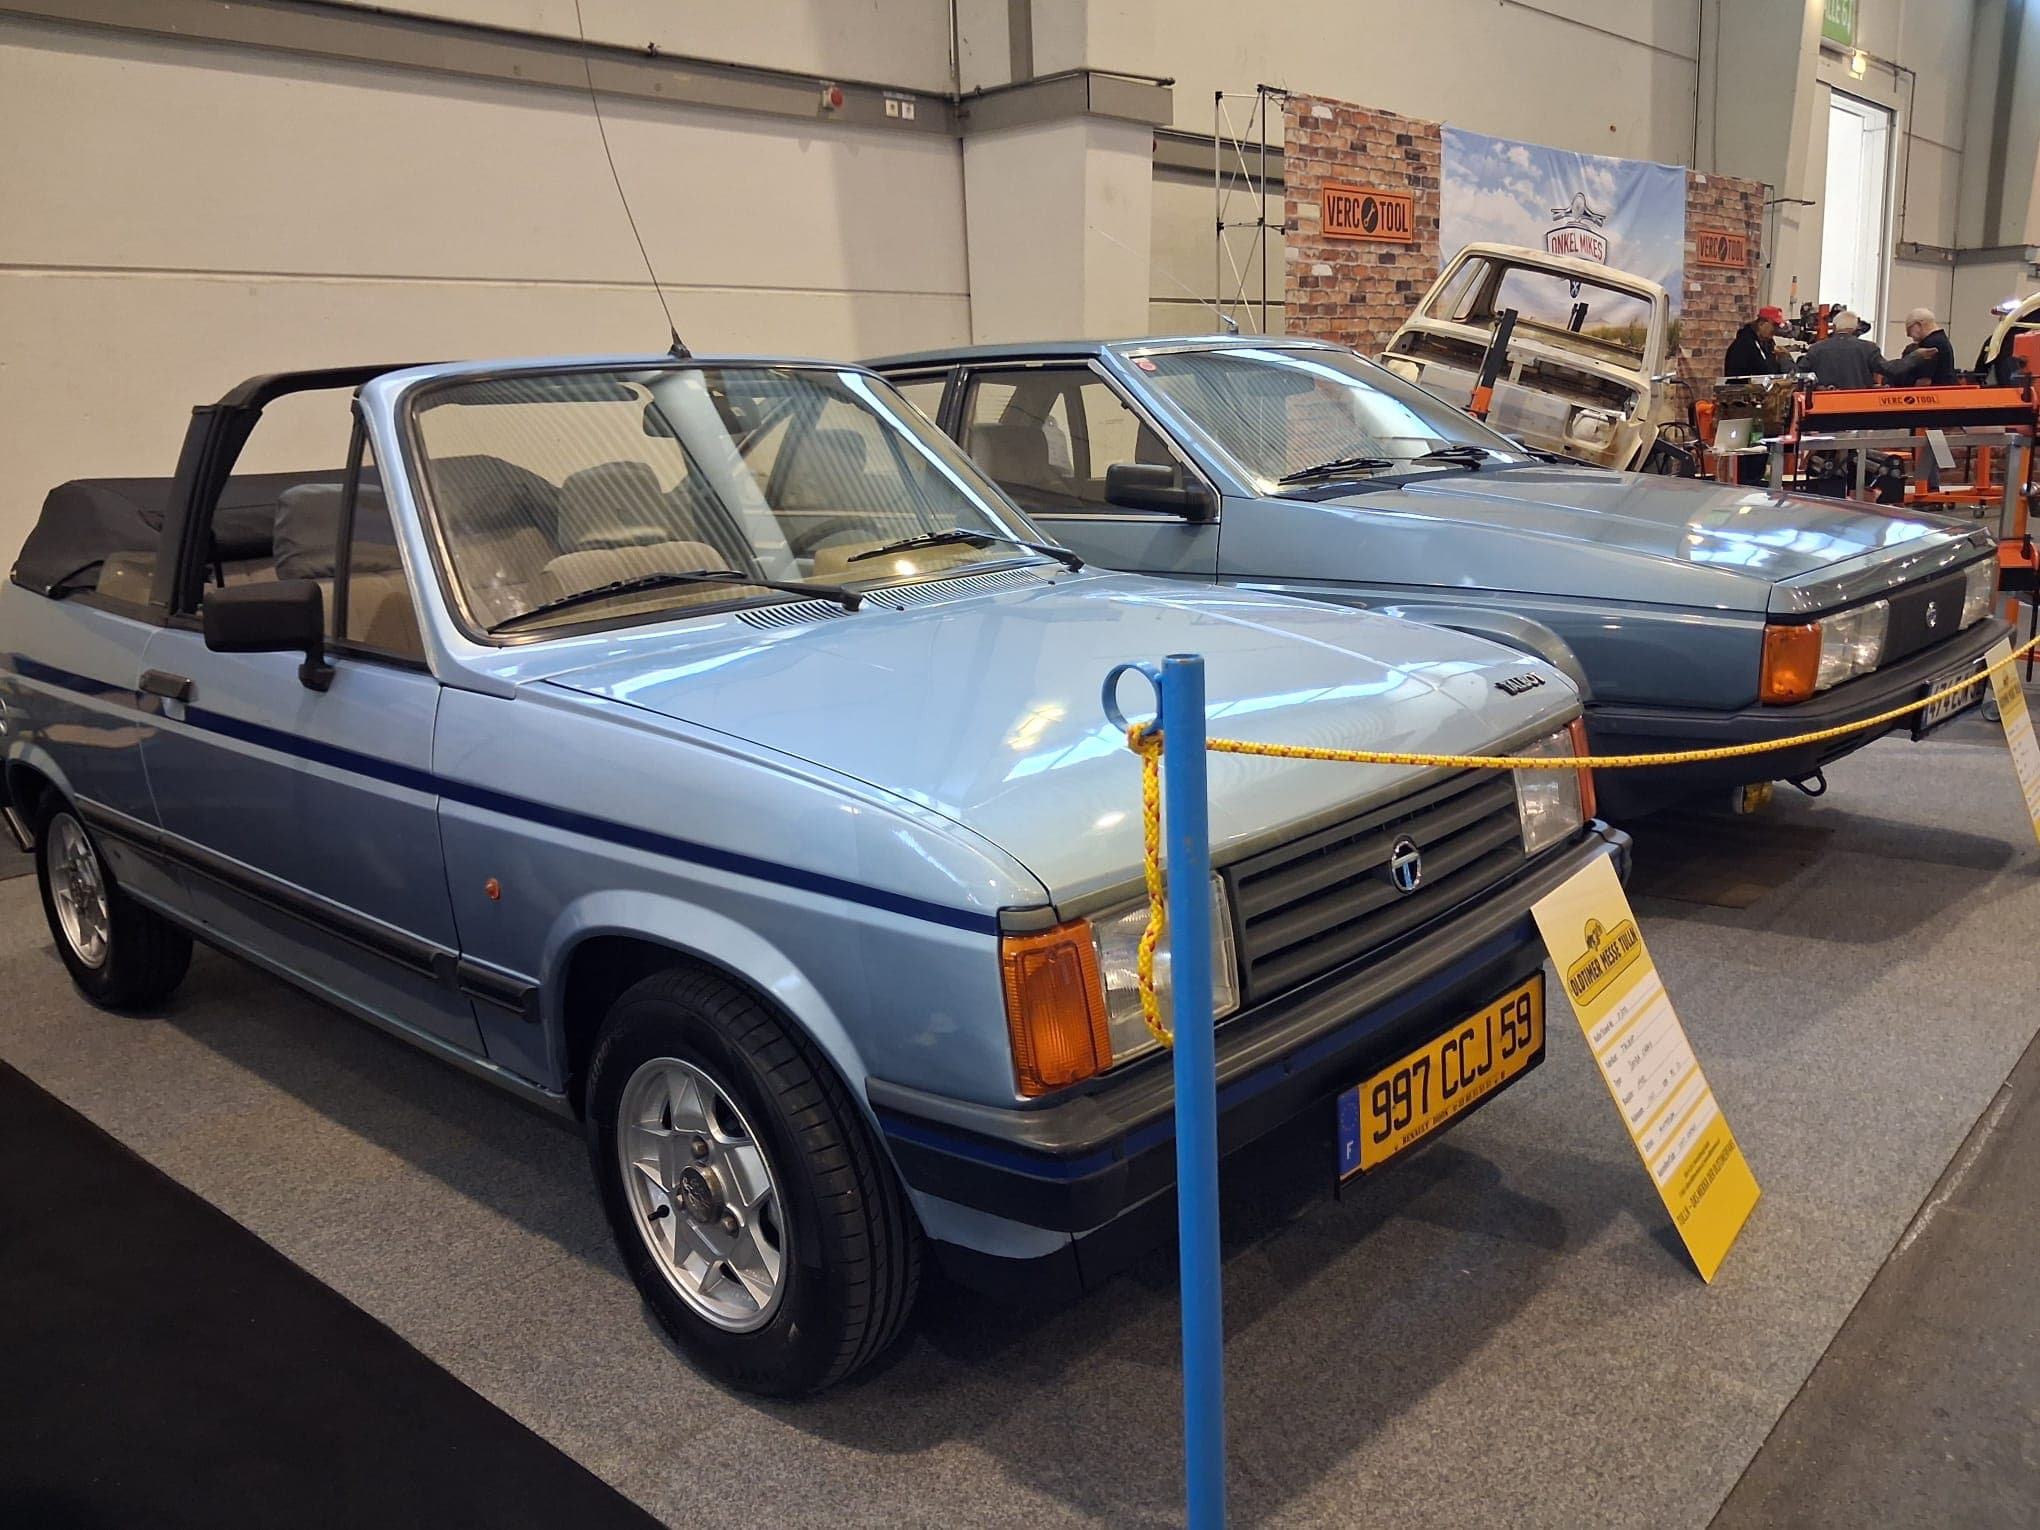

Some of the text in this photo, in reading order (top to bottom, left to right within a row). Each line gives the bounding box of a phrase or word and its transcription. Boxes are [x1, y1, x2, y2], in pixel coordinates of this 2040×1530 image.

[1379, 201, 1409, 233] TOOL
[1551, 232, 1603, 261] ONKEL MIKES
[1570, 926, 1639, 998] OLDTIMER MESSE TULLN
[1372, 1054, 1430, 1144] 997
[1441, 1016, 1492, 1100] CCJ
[1500, 992, 1532, 1060] 59
[1346, 1140, 1354, 1160] F
